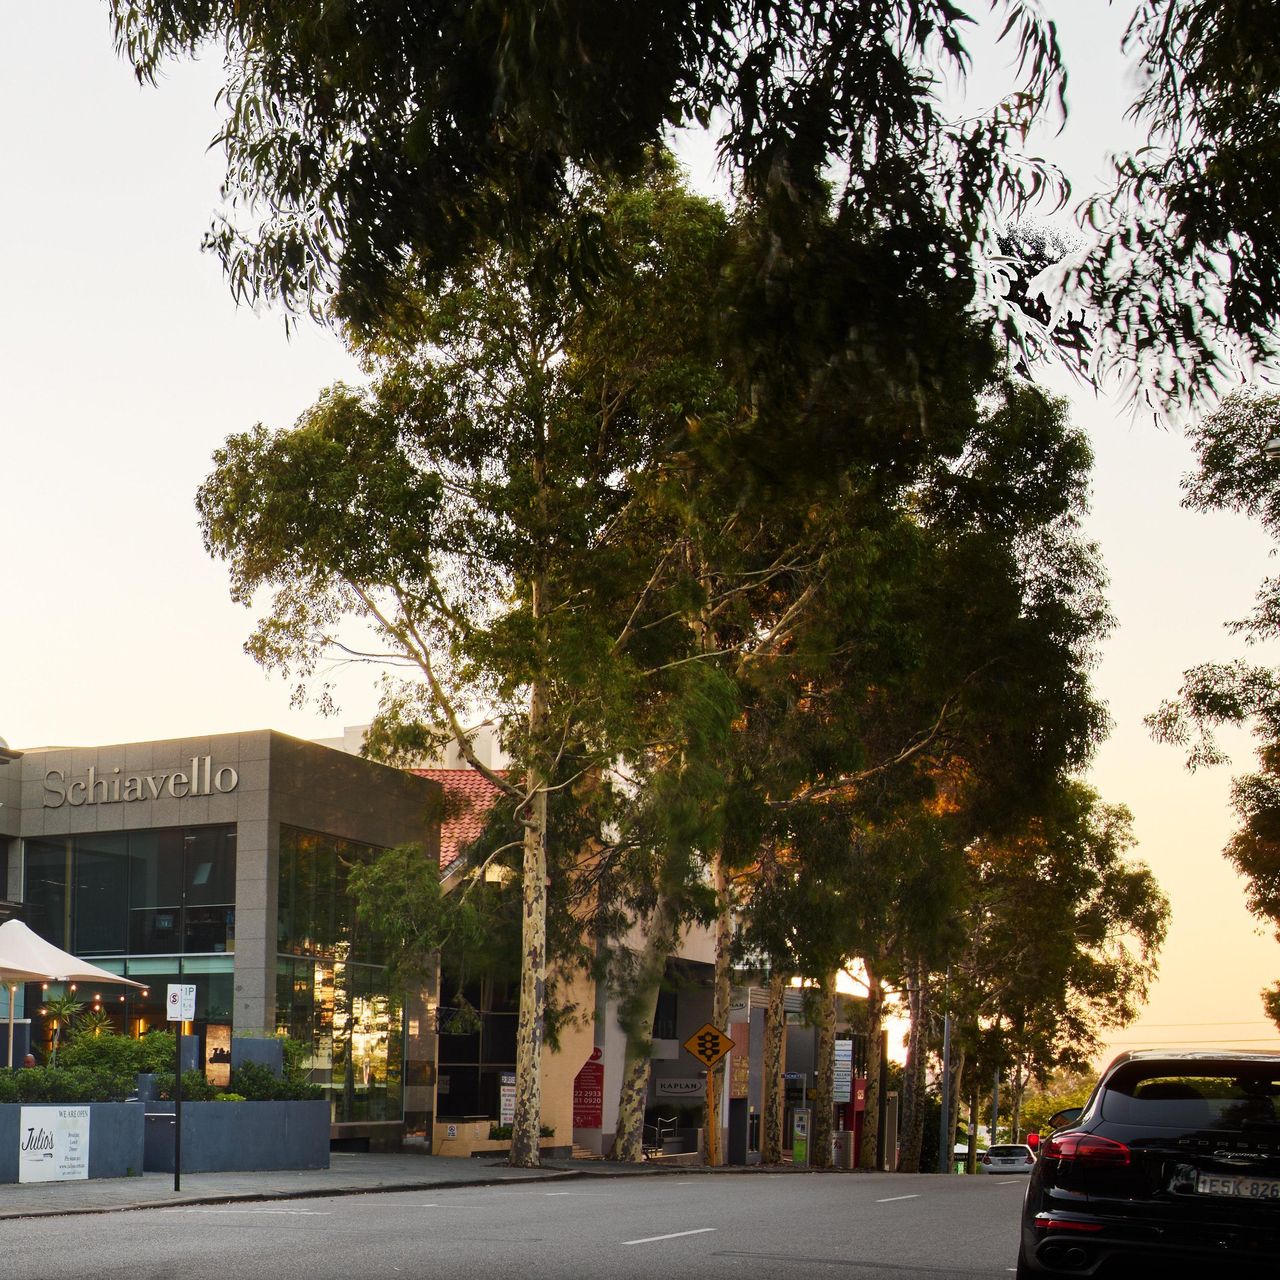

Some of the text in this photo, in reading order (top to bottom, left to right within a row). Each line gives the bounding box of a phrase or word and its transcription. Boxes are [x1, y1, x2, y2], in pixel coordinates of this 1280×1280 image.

[43, 755, 239, 808] Schiavello
[58, 1110, 89, 1118] WE ARE OPEN
[22, 1128, 54, 1151] Julio's
